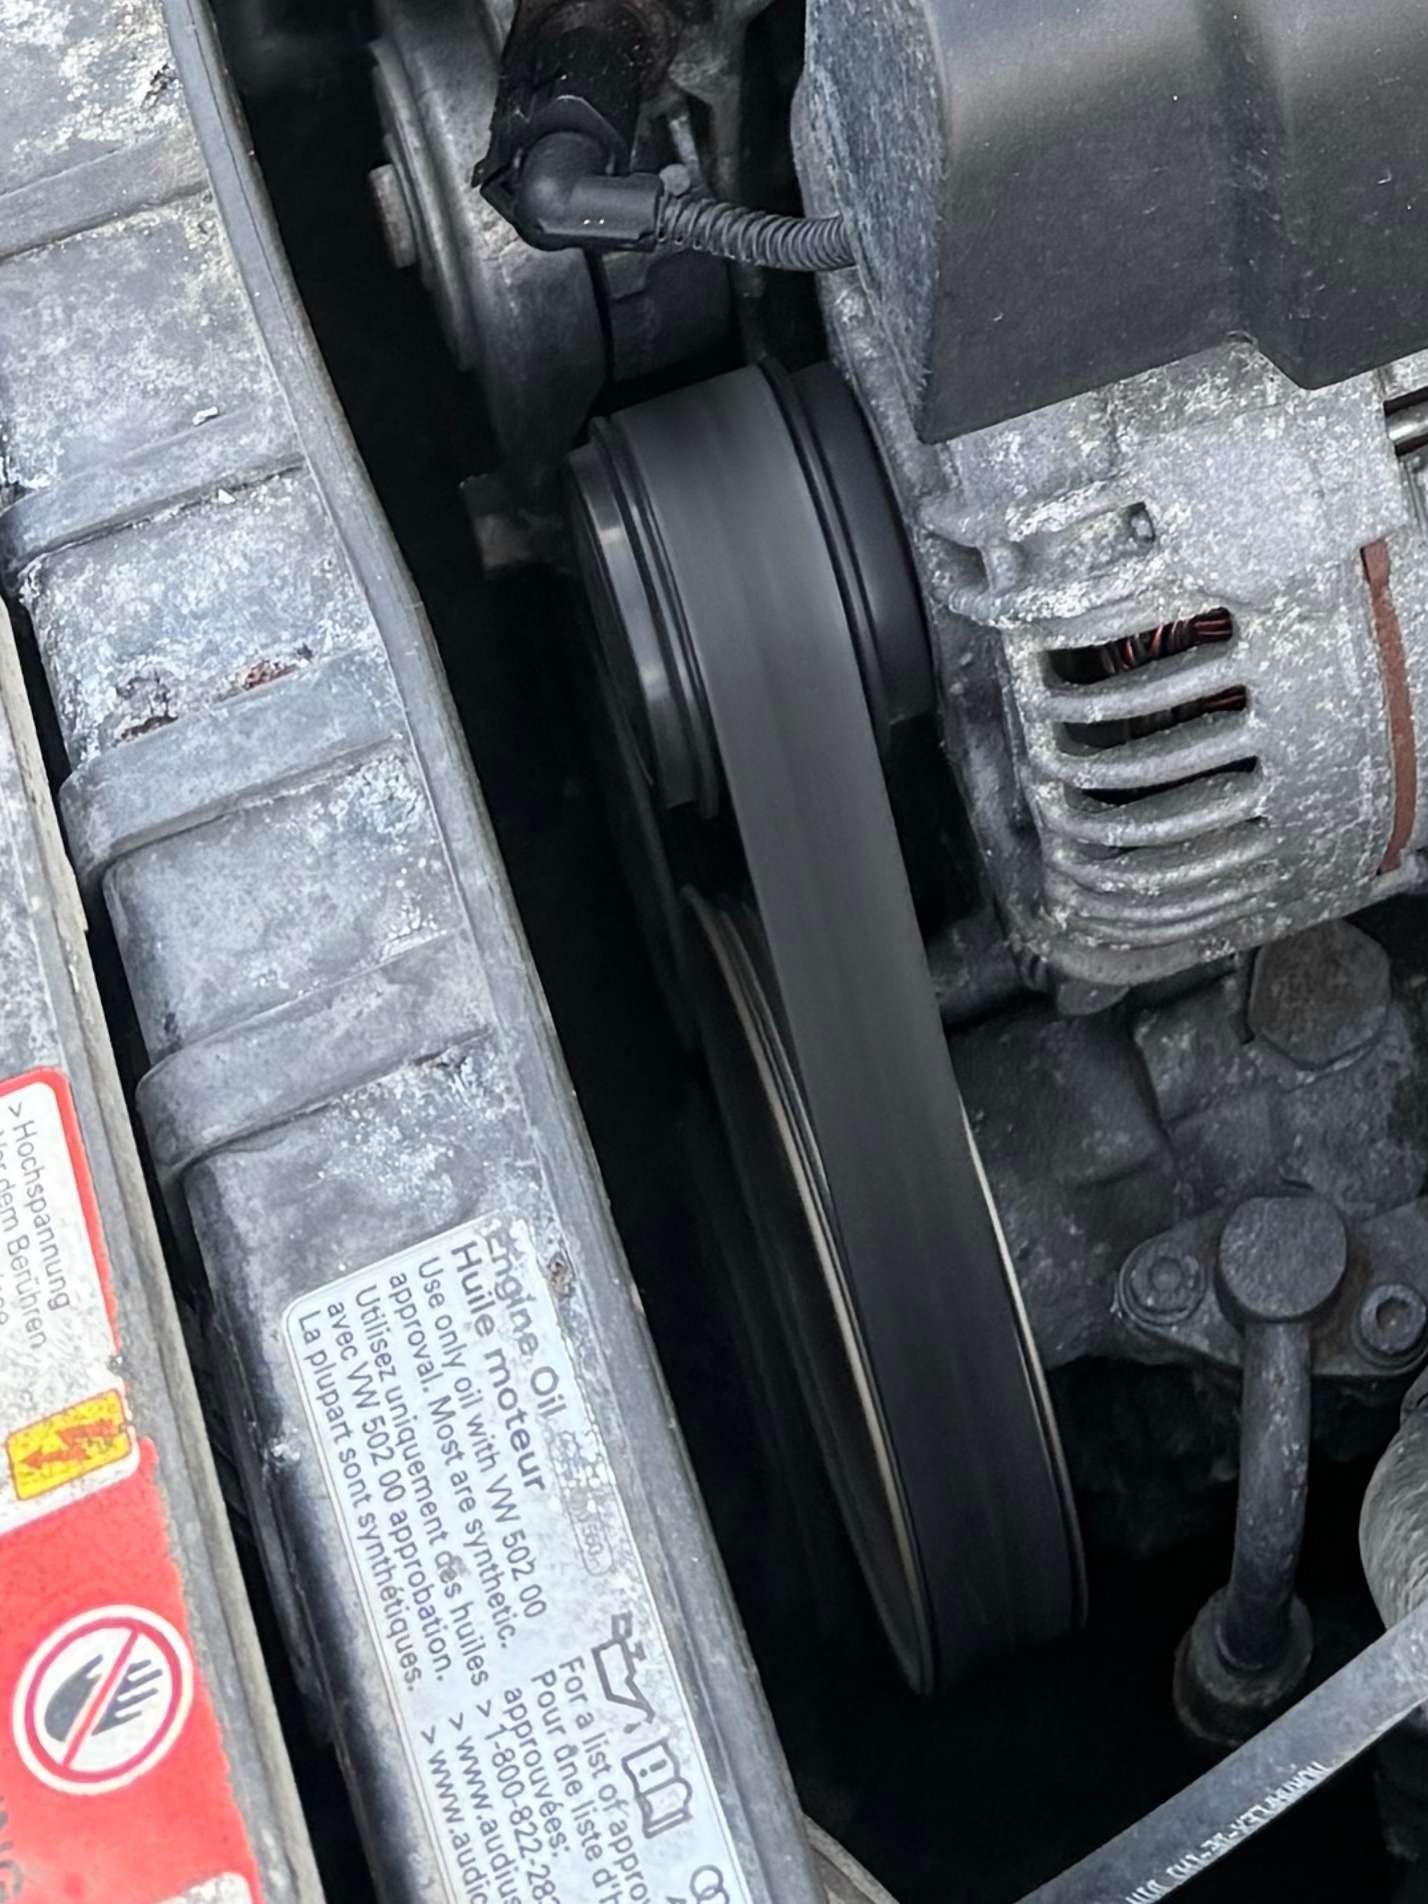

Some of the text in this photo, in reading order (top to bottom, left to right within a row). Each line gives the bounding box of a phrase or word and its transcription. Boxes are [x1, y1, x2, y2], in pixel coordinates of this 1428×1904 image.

[7, 1234, 48, 1350] Berühren
[13, 1119, 71, 1311] Hochspannung
[450, 1240, 546, 1491] Huile moteur
[484, 1232, 568, 1420] Engine Oil
[298, 1310, 423, 1692] La plupart sont synthétiques.
[327, 1301, 452, 1682] avec VW 502 00 approbation.
[355, 1285, 490, 1687] Utilisez uniquement des huiles
[388, 1272, 518, 1649] approval. Most are synthetic.
[418, 1256, 548, 1618] Use only oil with VW 502 00
[503, 1688, 571, 1858] approuvées:
[531, 1669, 568, 1736] Pour
[571, 1799, 604, 1862] liste
[559, 1655, 590, 1704] For
[575, 1711, 595, 1730] a
[582, 1732, 613, 1780] list
[485, 1724, 560, 1904] 1-800-822-28
[597, 1783, 629, 1814] of
